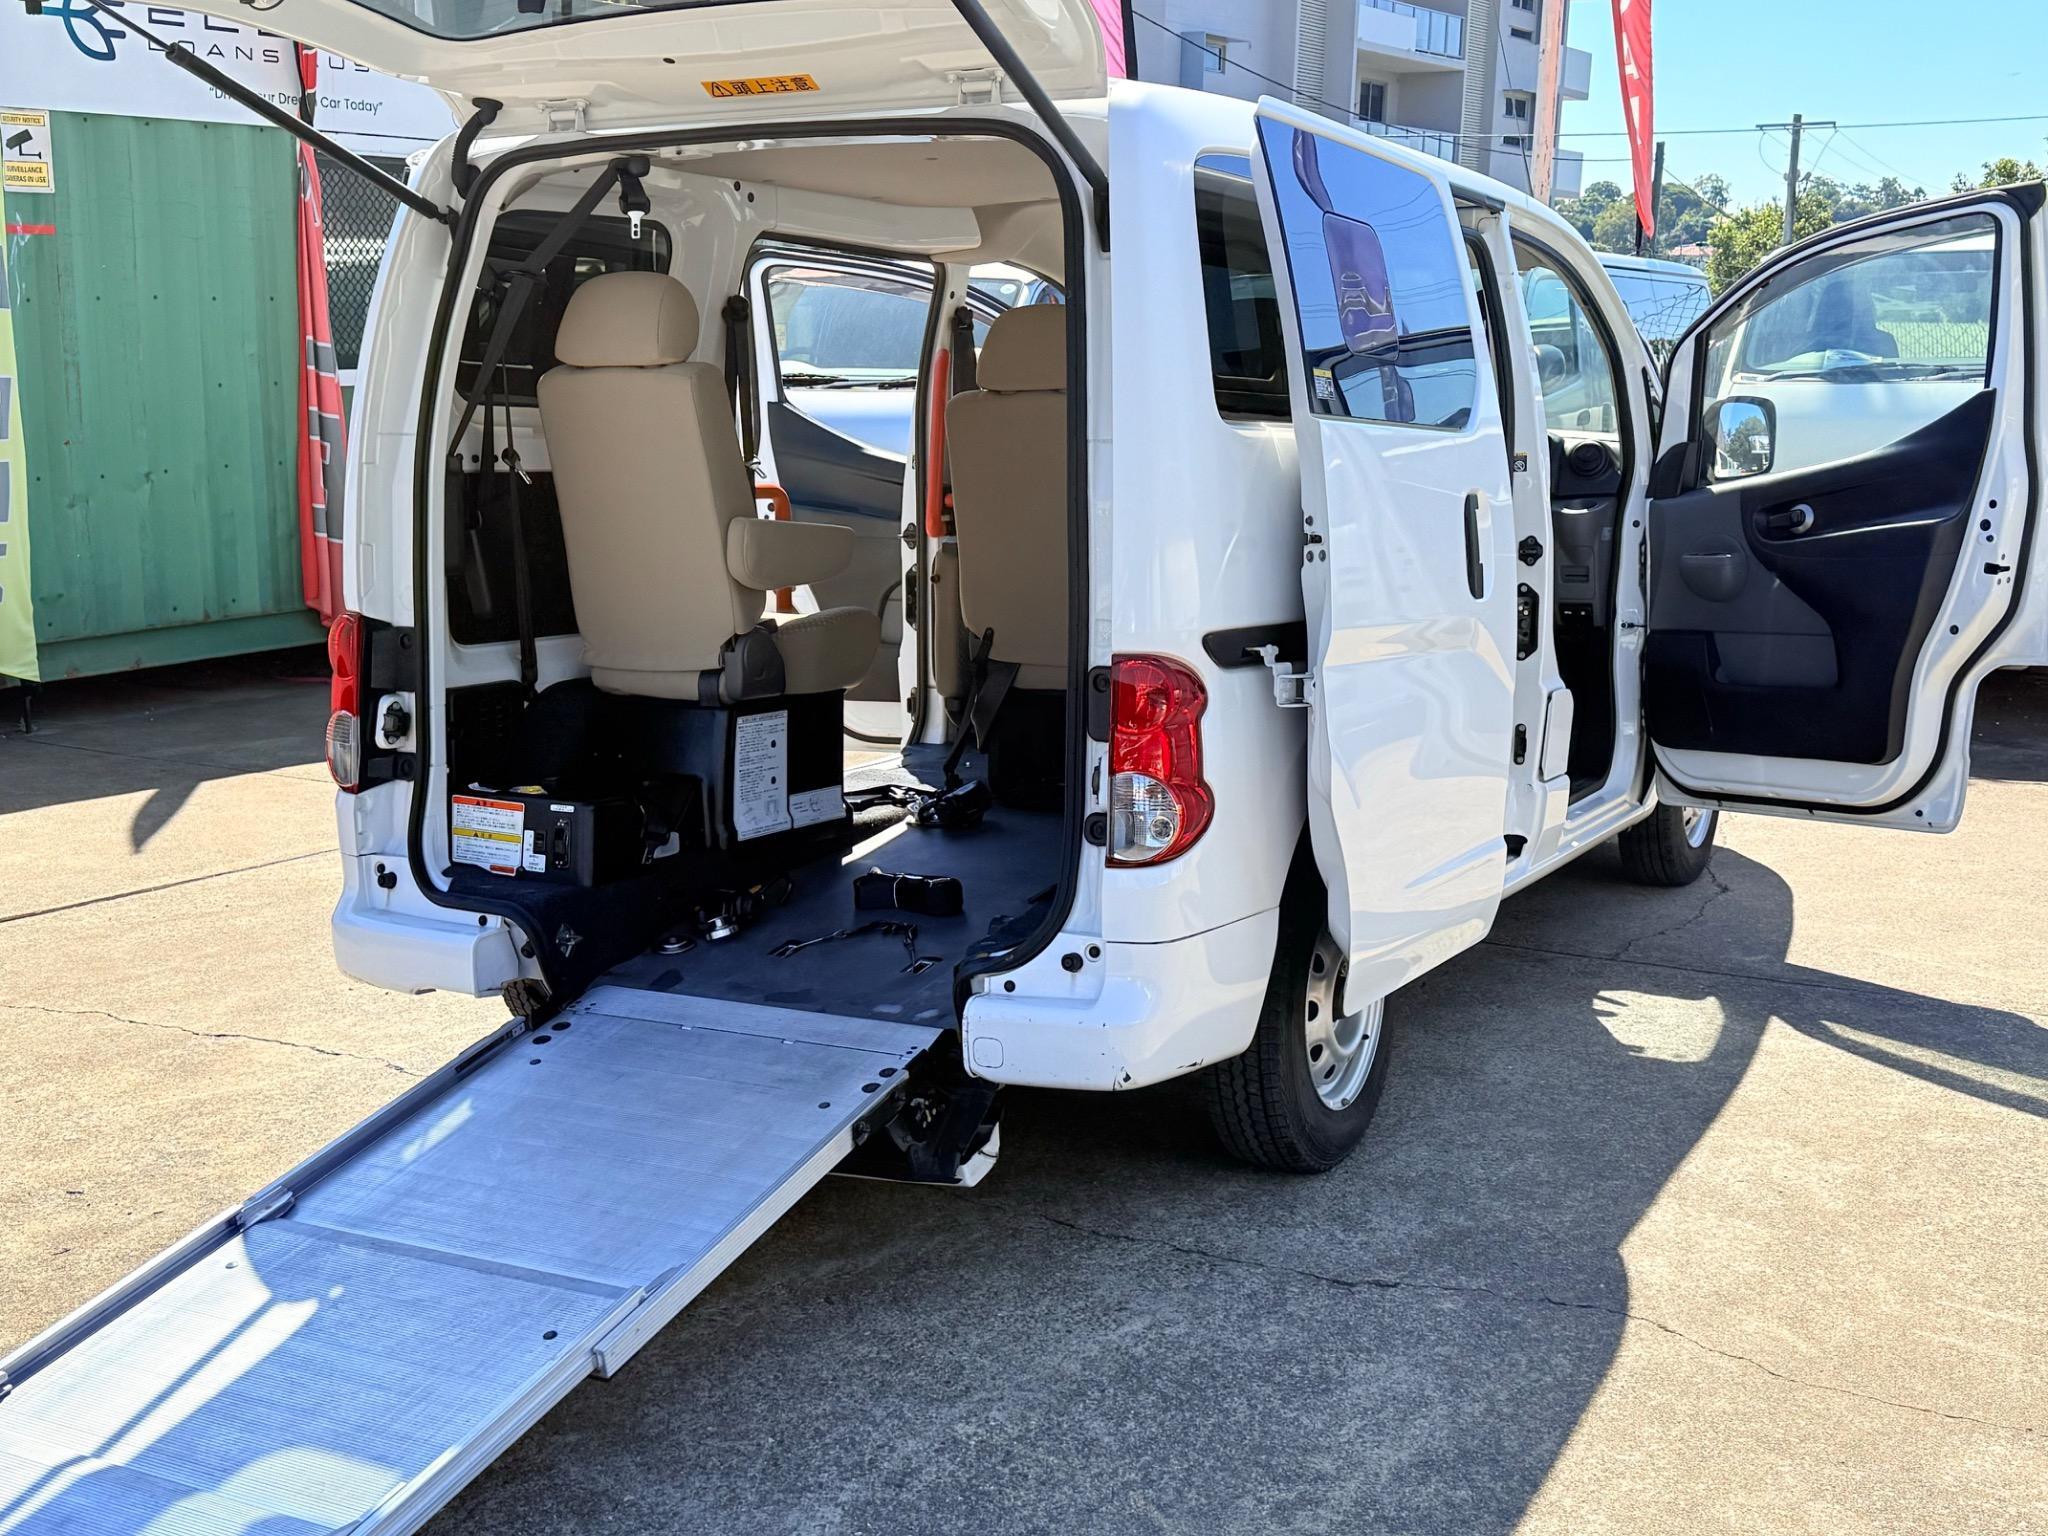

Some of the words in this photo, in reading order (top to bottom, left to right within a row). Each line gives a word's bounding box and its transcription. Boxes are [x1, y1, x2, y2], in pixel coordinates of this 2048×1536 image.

[729, 77, 813, 95] 頭上注意
[320, 97, 340, 108] Car
[22, 116, 42, 124] NOTICE
[6, 165, 43, 174] SURVEILLANCE
